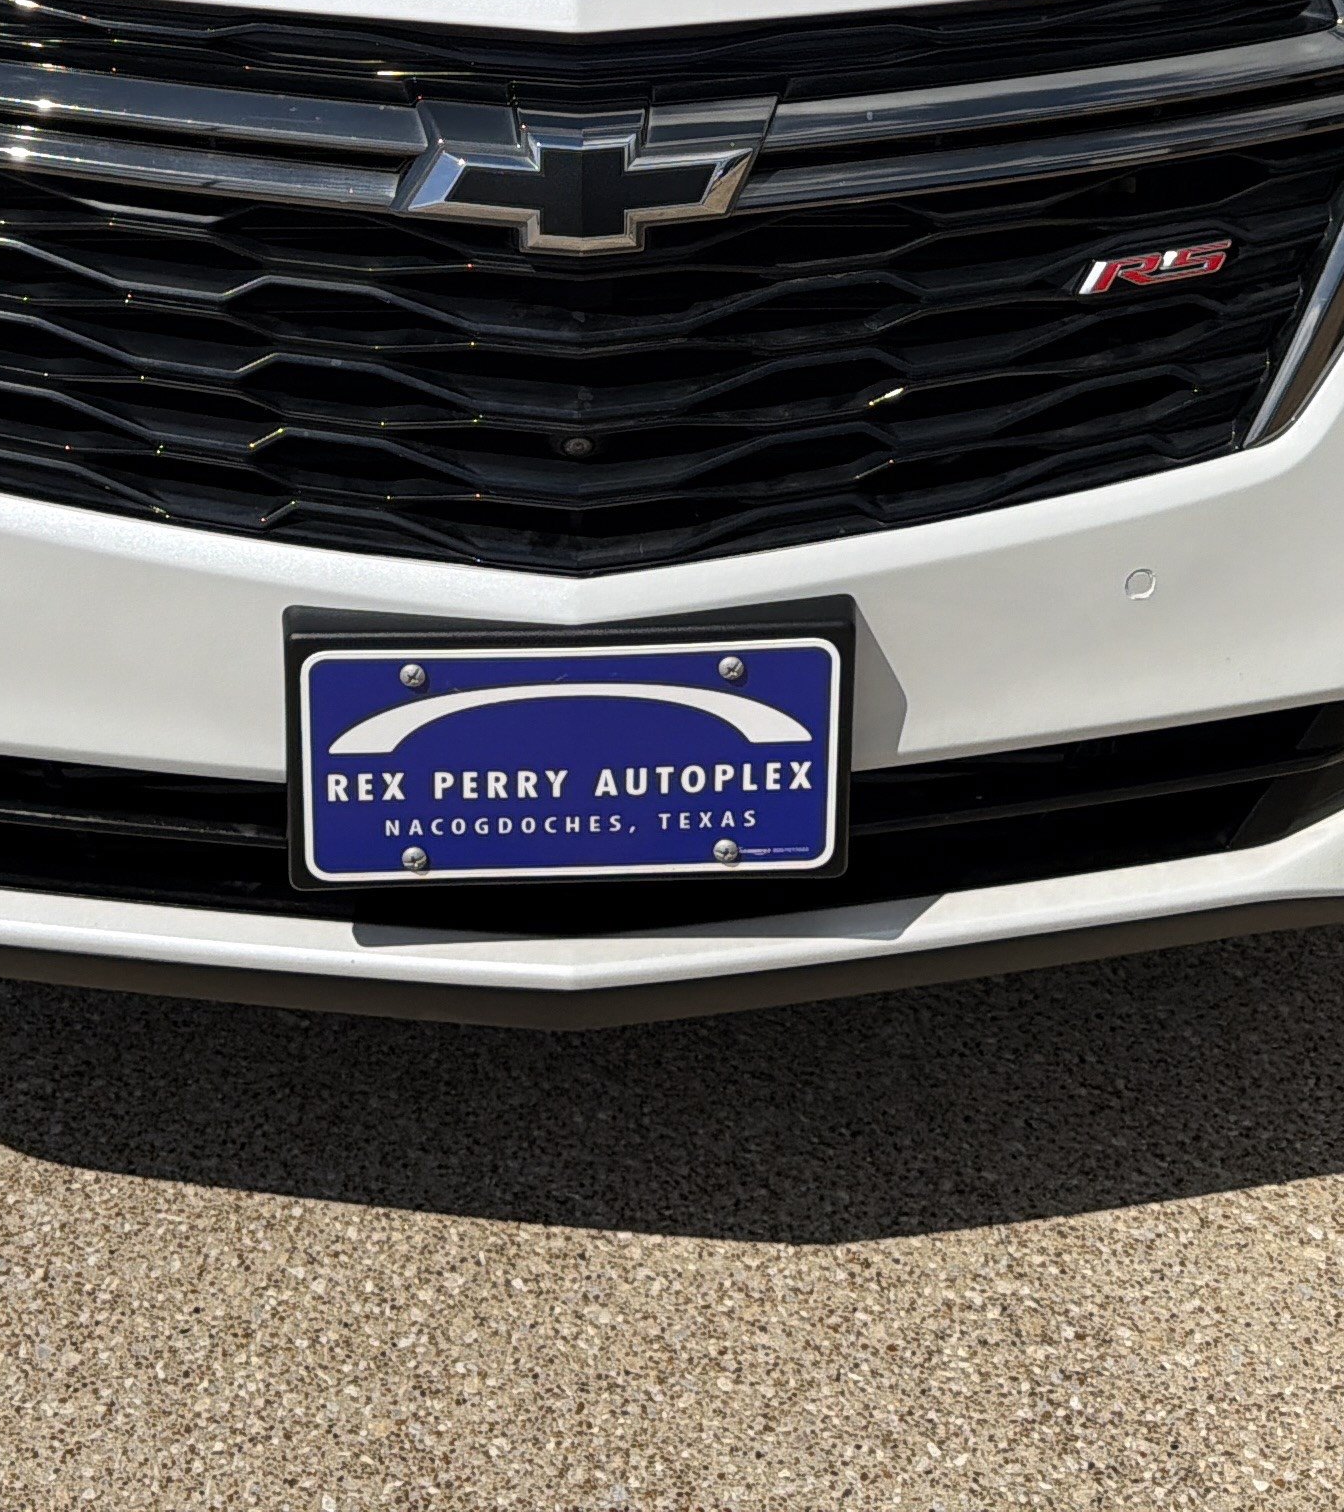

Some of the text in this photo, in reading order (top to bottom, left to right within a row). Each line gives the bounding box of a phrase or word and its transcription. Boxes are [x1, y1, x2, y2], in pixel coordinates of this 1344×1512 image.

[1079, 239, 1233, 295] RS
[327, 761, 813, 802] REX PERRY AUTOPLEX
[385, 809, 758, 837] NACOGDOCHES, TEXAS
